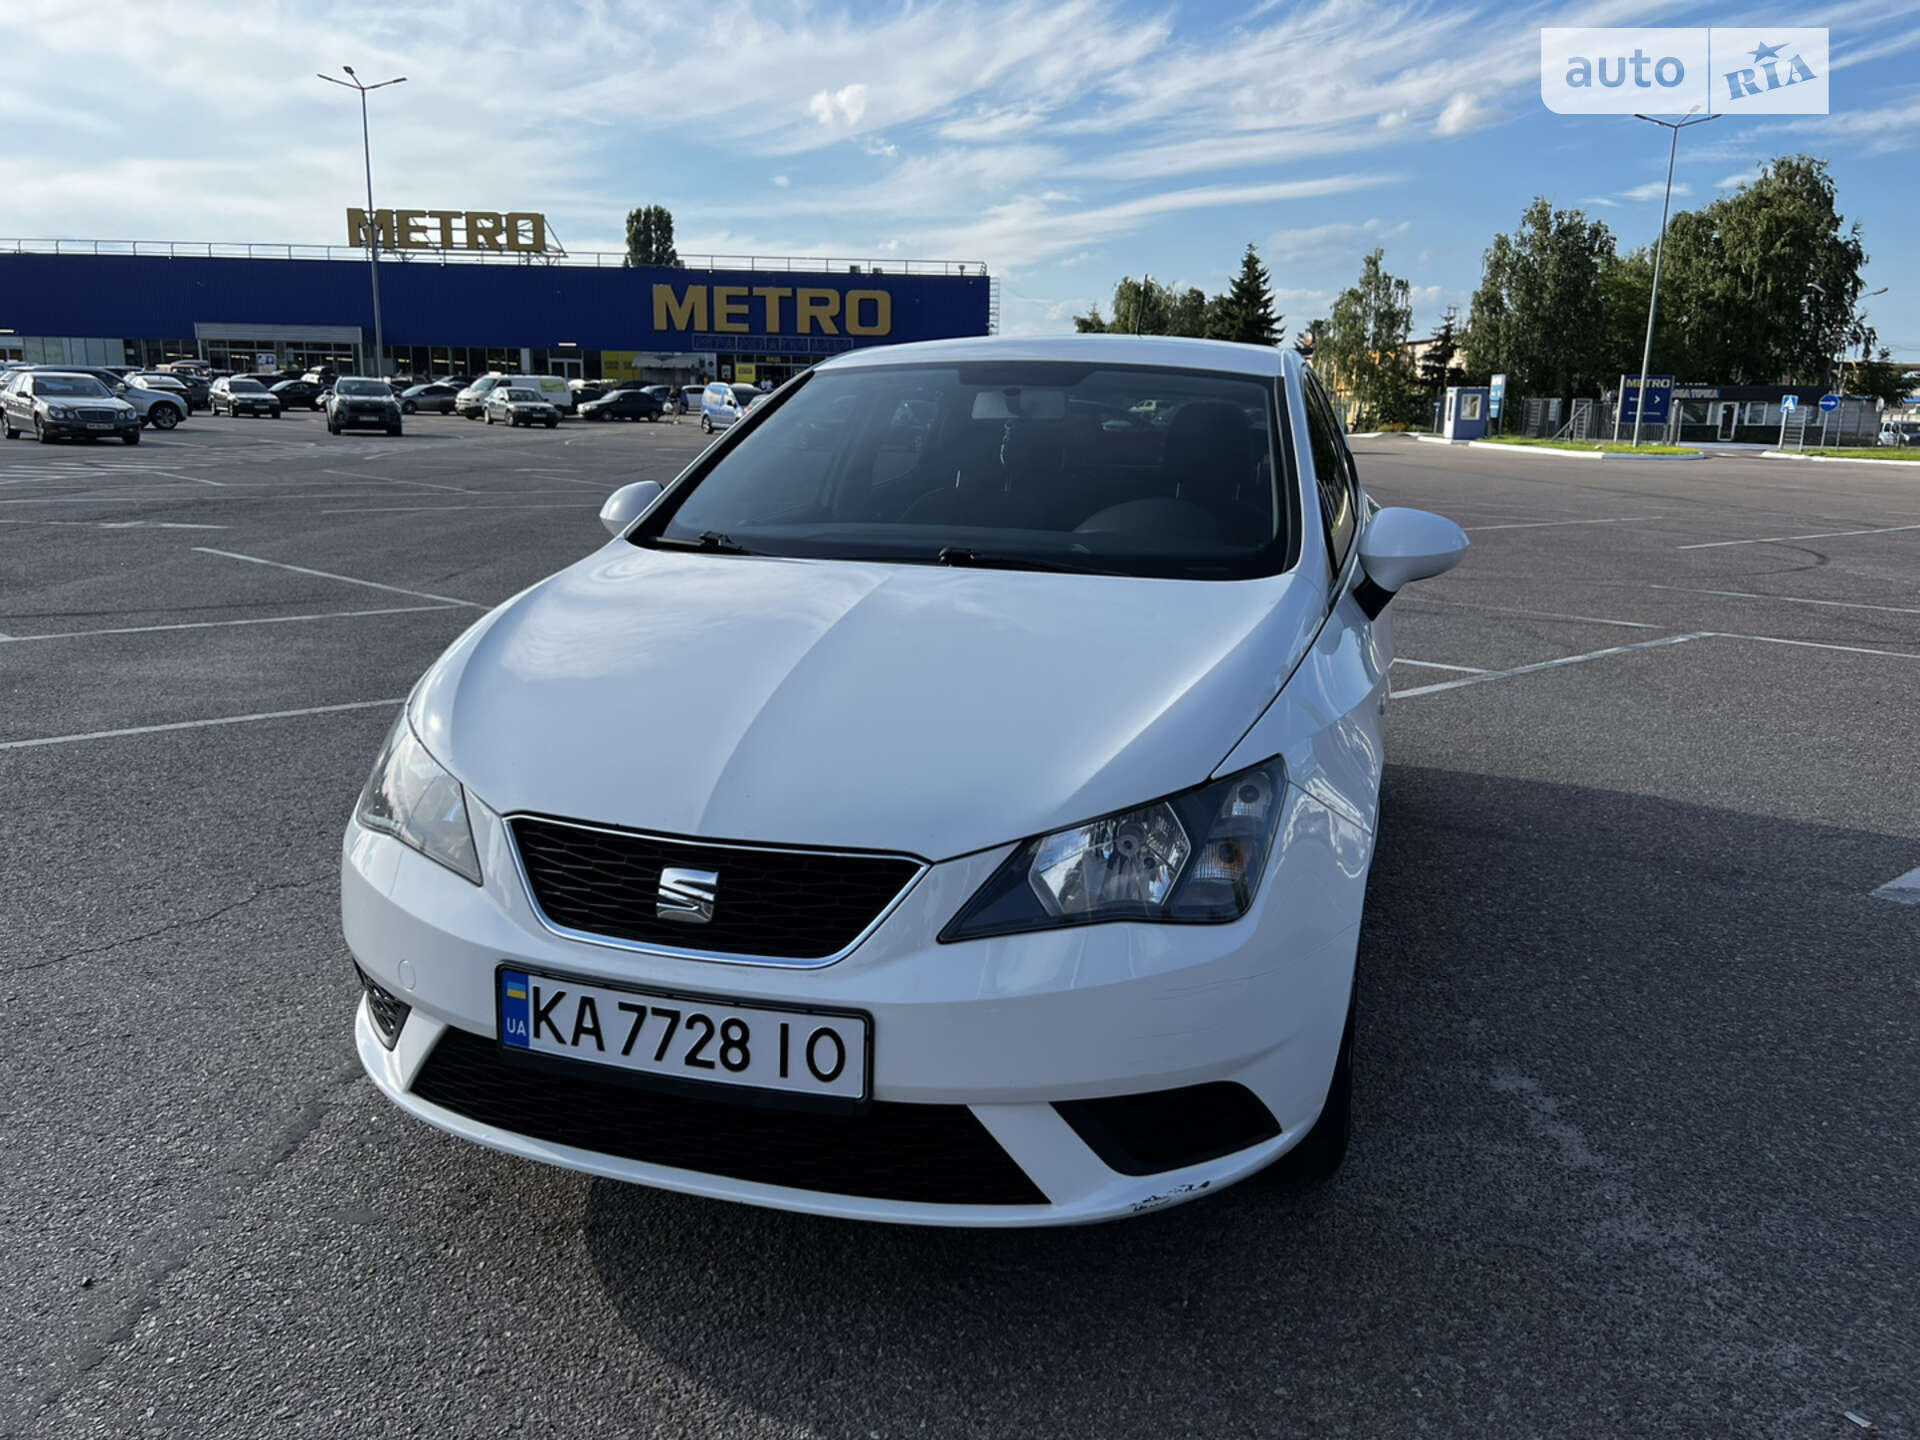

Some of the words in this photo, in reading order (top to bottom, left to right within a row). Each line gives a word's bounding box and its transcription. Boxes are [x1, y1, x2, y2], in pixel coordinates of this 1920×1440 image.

[346, 208, 546, 252] METRO
[652, 284, 892, 337] METRO
[506, 1016, 527, 1037] UA
[617, 1001, 751, 1073] 7728
